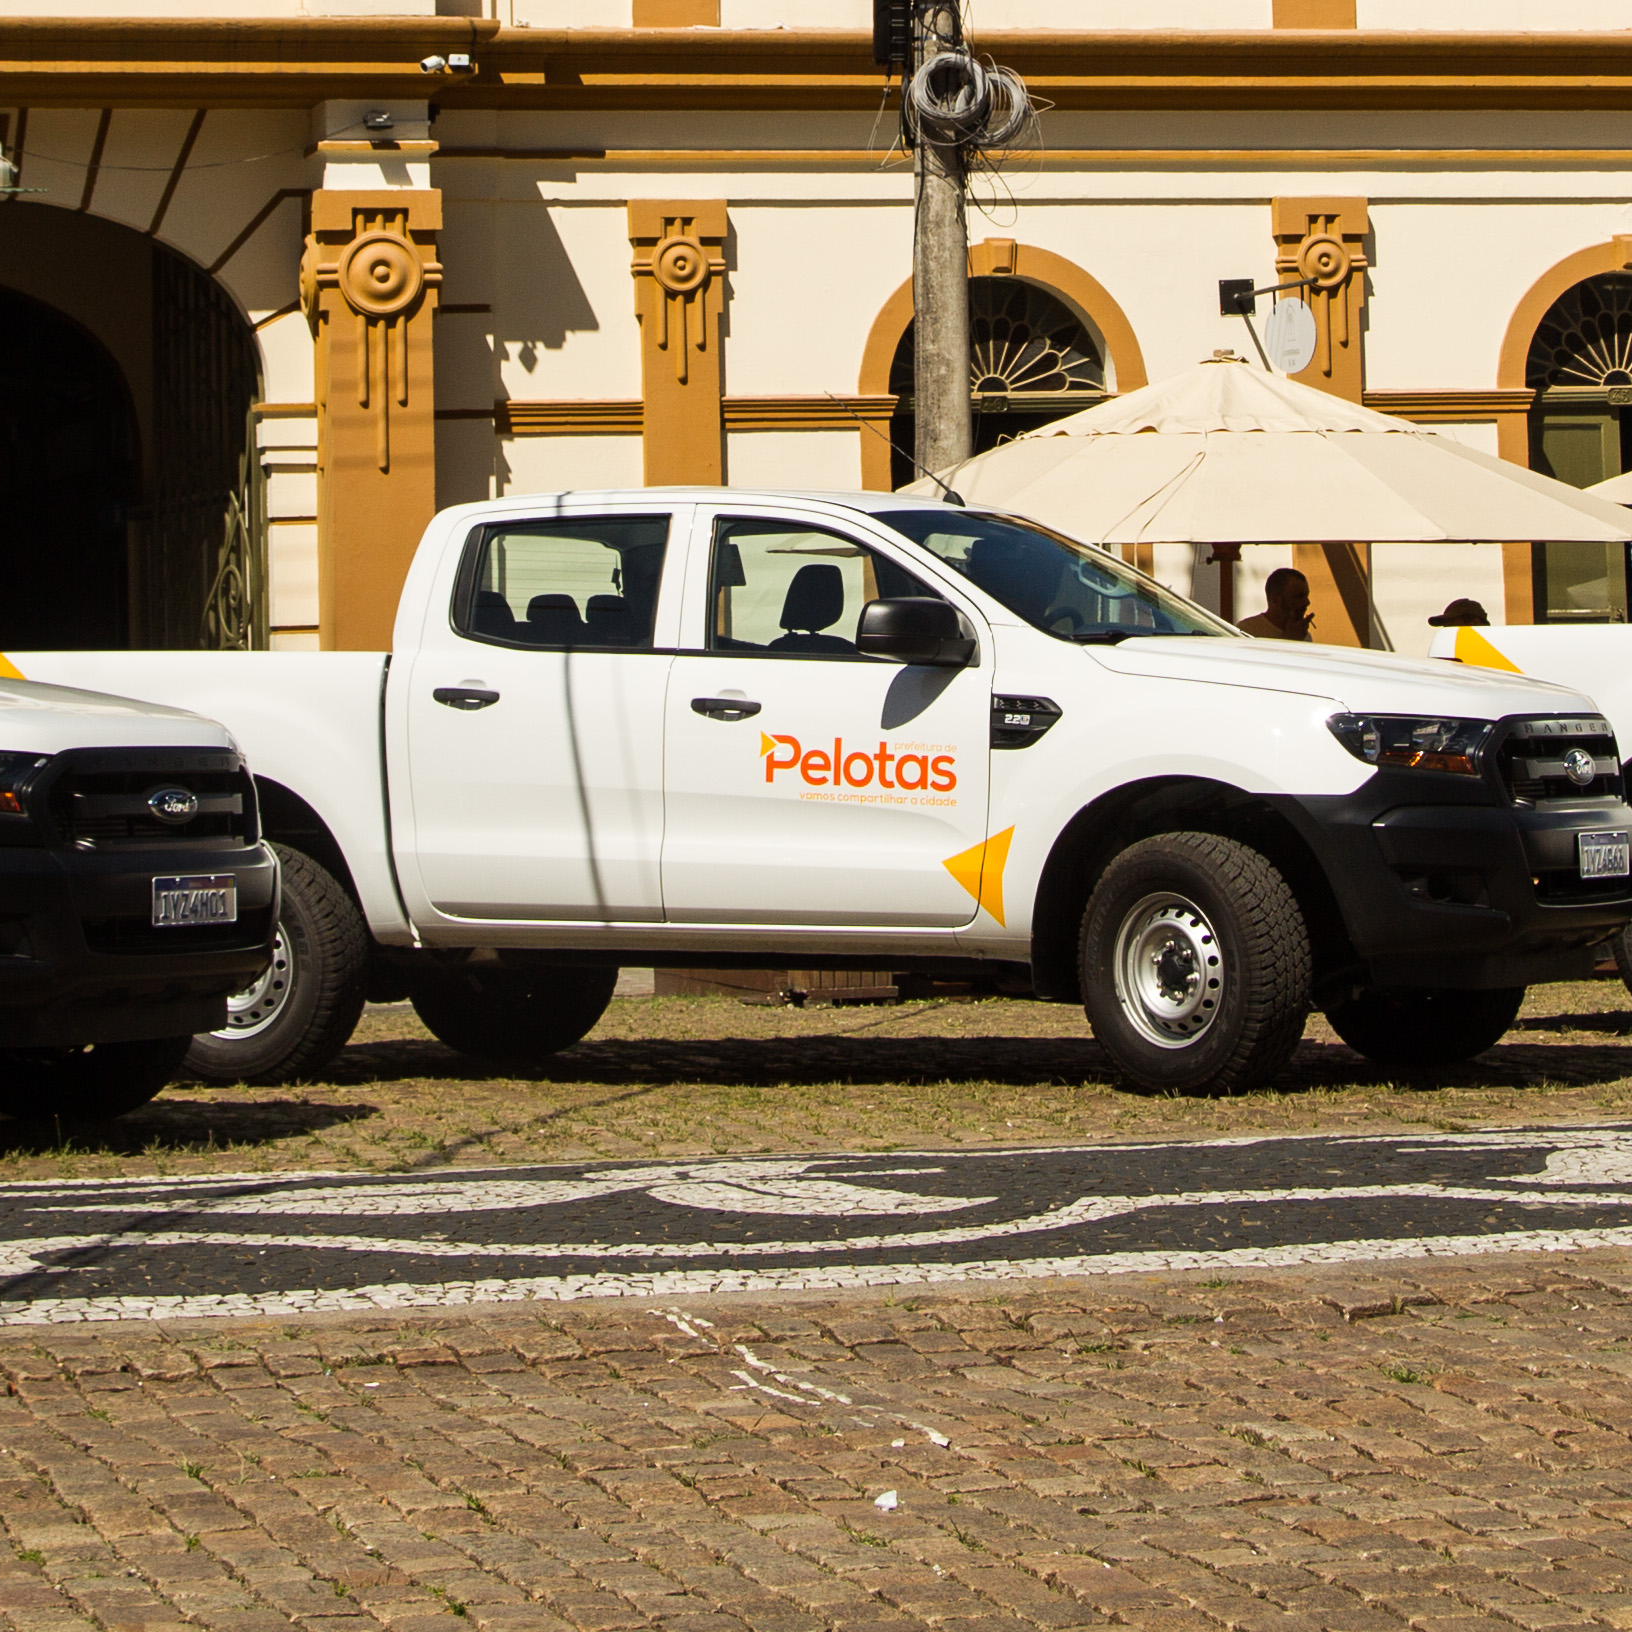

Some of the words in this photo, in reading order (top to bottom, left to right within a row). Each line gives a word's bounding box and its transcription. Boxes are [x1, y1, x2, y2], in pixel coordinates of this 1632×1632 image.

[1524, 723, 1608, 734] RANGER
[893, 741, 943, 753] prefeitura
[944, 744, 957, 754] de
[764, 734, 958, 793] Pelotas
[799, 791, 835, 802] vamos
[837, 792, 908, 805] compartilhar
[910, 796, 918, 805] a
[919, 795, 958, 807] cidade
[159, 890, 228, 919] IYZ4H01
